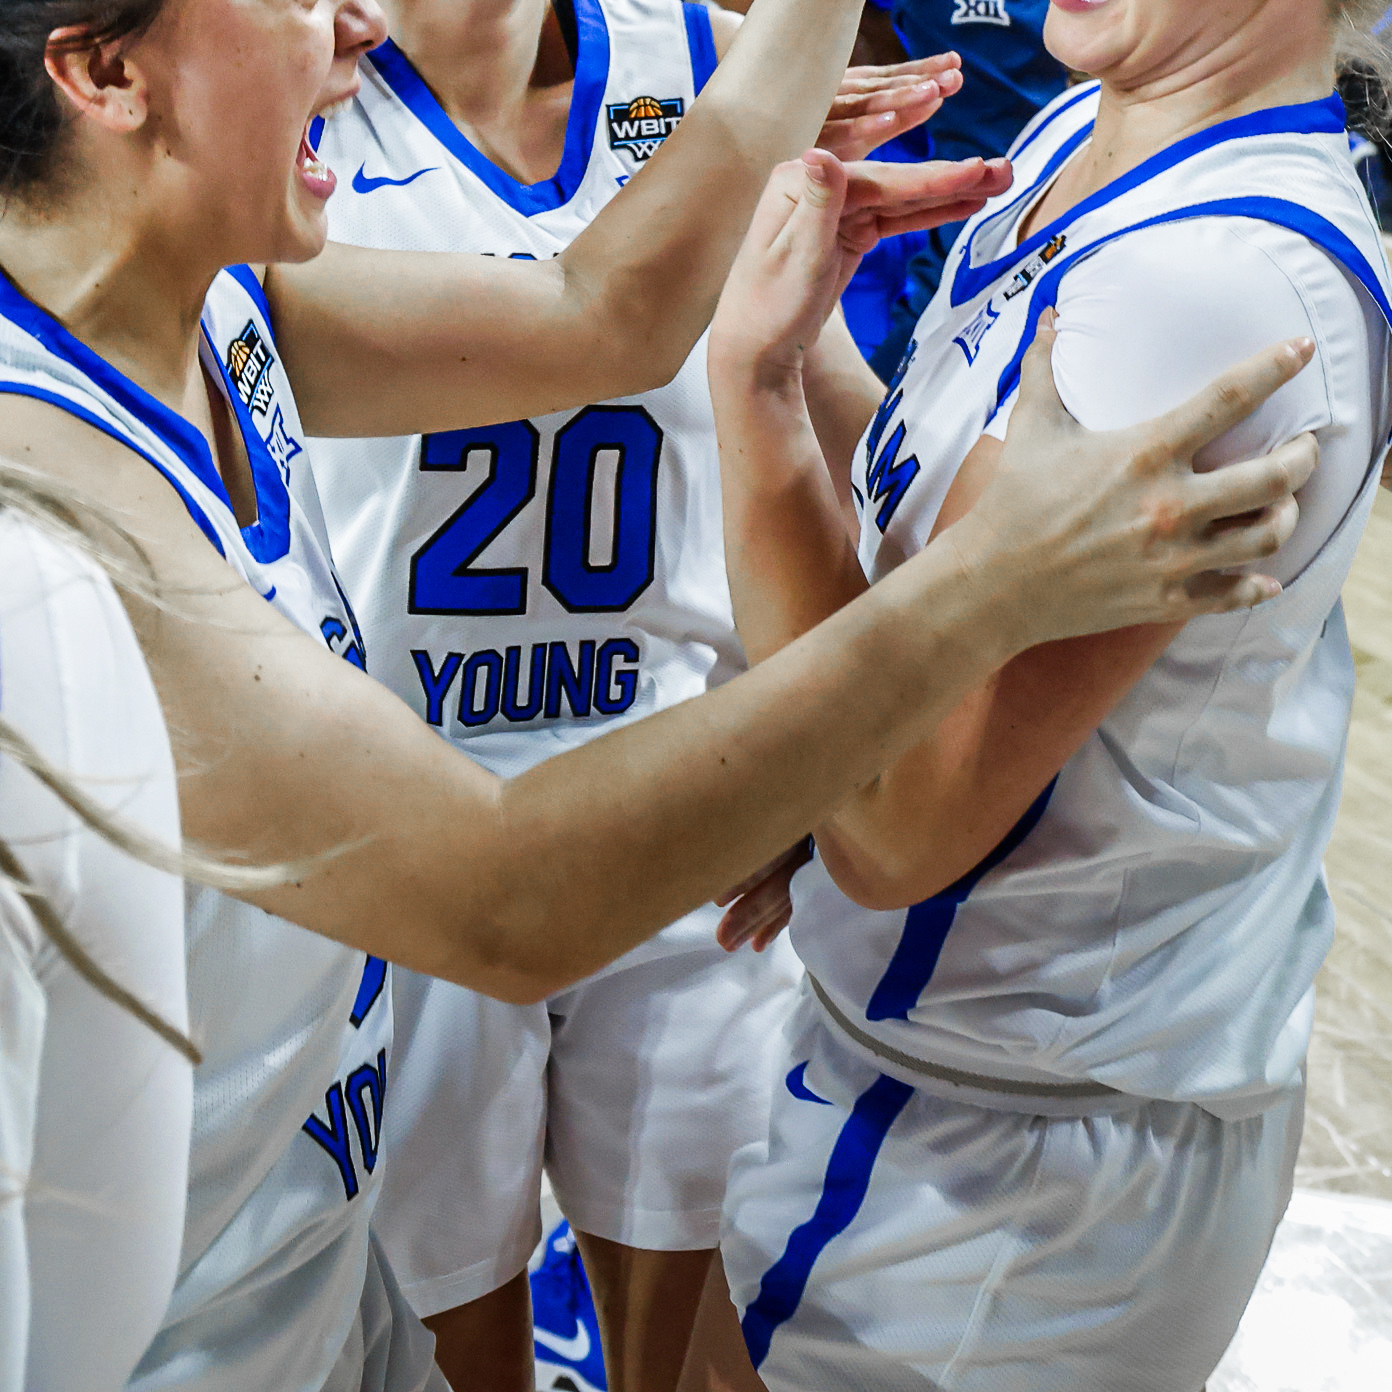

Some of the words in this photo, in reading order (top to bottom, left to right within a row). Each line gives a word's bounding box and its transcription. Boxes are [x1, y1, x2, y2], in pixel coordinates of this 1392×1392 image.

[611, 117, 682, 139] WBIT
[237, 339, 266, 405] WBIT
[408, 404, 664, 616] 20
[410, 639, 640, 727] YOUNG
